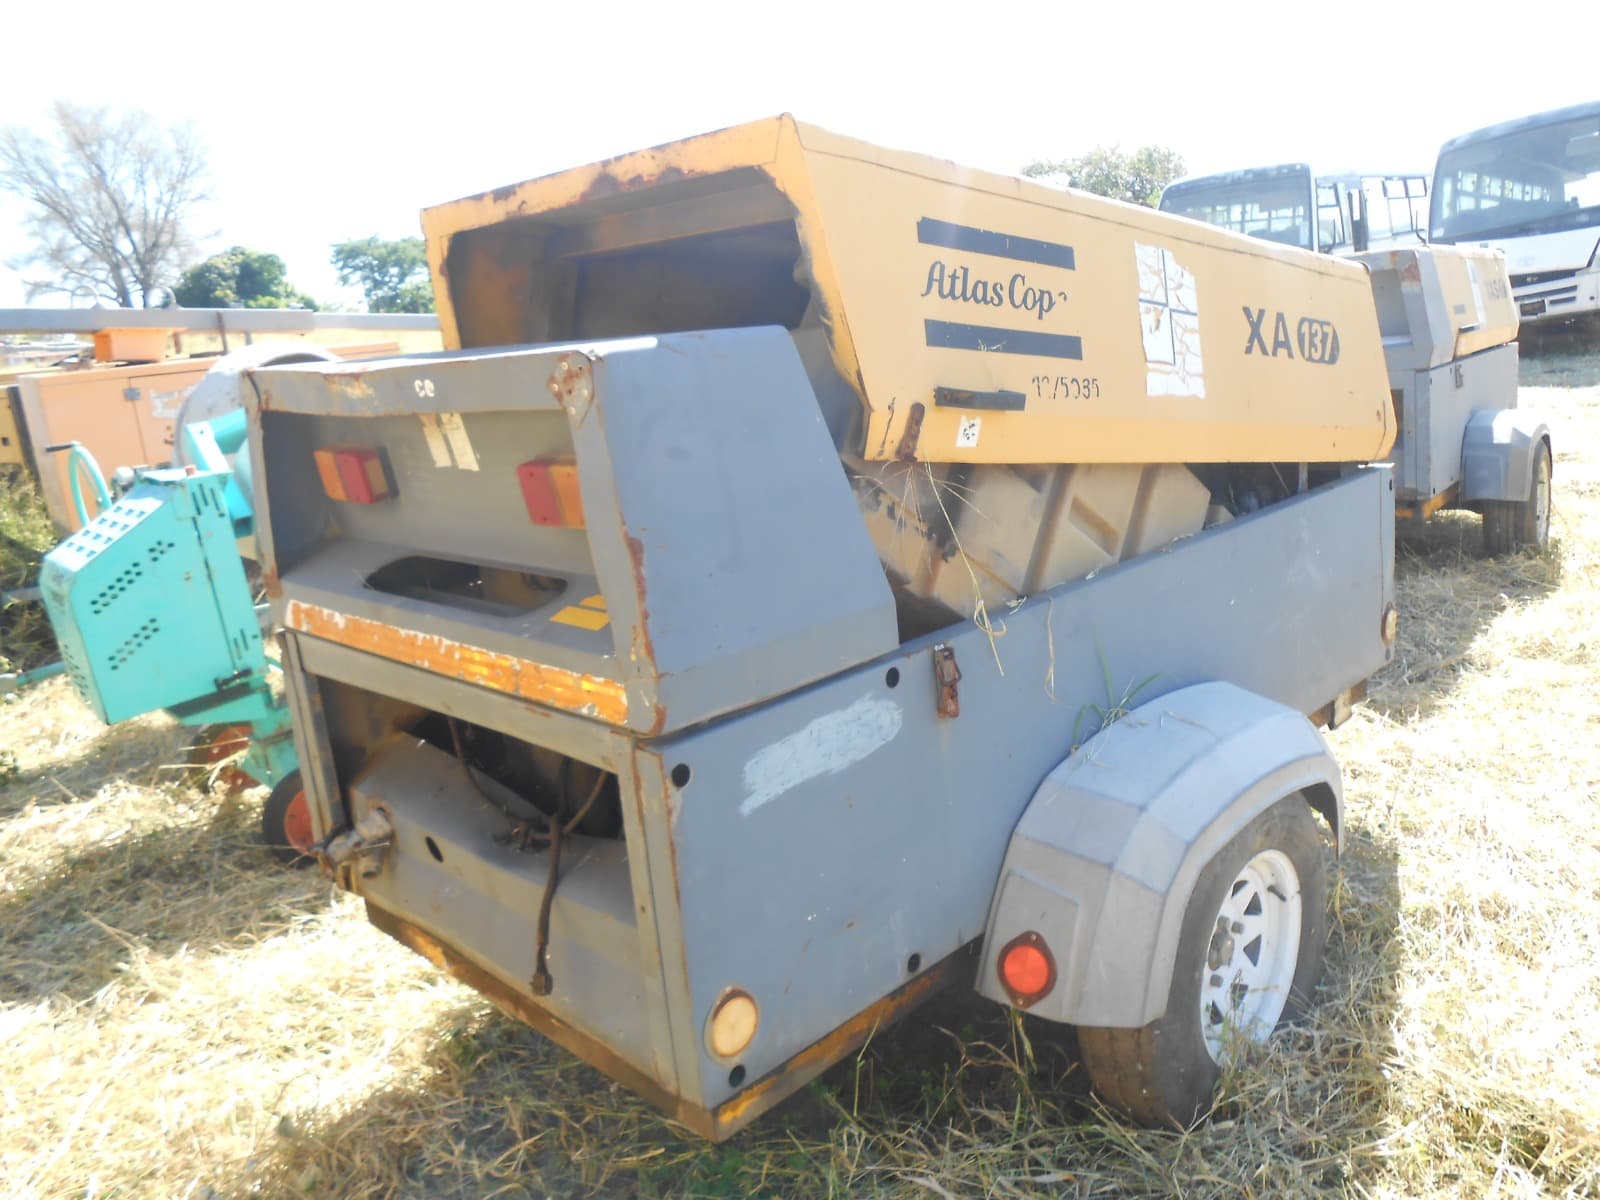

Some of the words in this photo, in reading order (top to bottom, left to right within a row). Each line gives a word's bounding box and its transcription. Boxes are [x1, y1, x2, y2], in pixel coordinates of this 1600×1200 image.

[921, 261, 1004, 307] Atlas
[1242, 306, 1295, 360] XA
[1299, 318, 1337, 363] 137
